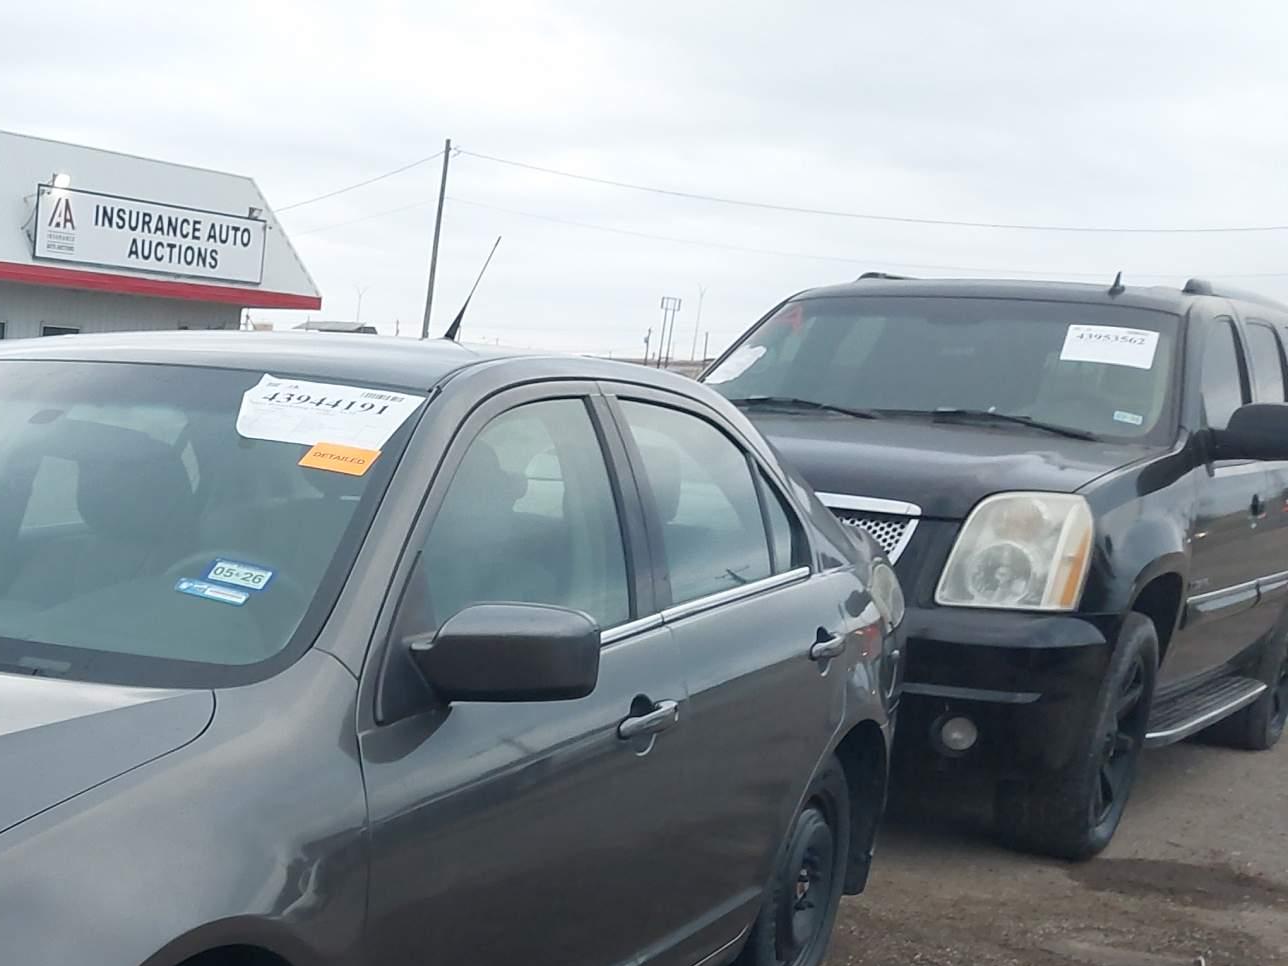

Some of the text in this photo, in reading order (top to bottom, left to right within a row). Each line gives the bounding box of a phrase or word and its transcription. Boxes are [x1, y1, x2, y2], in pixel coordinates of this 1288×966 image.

[94, 204, 251, 247] INSURANCE AUTO
[128, 238, 219, 269] AUCTIONS
[262, 391, 390, 415] 43944191
[312, 451, 367, 465] DETAILED
